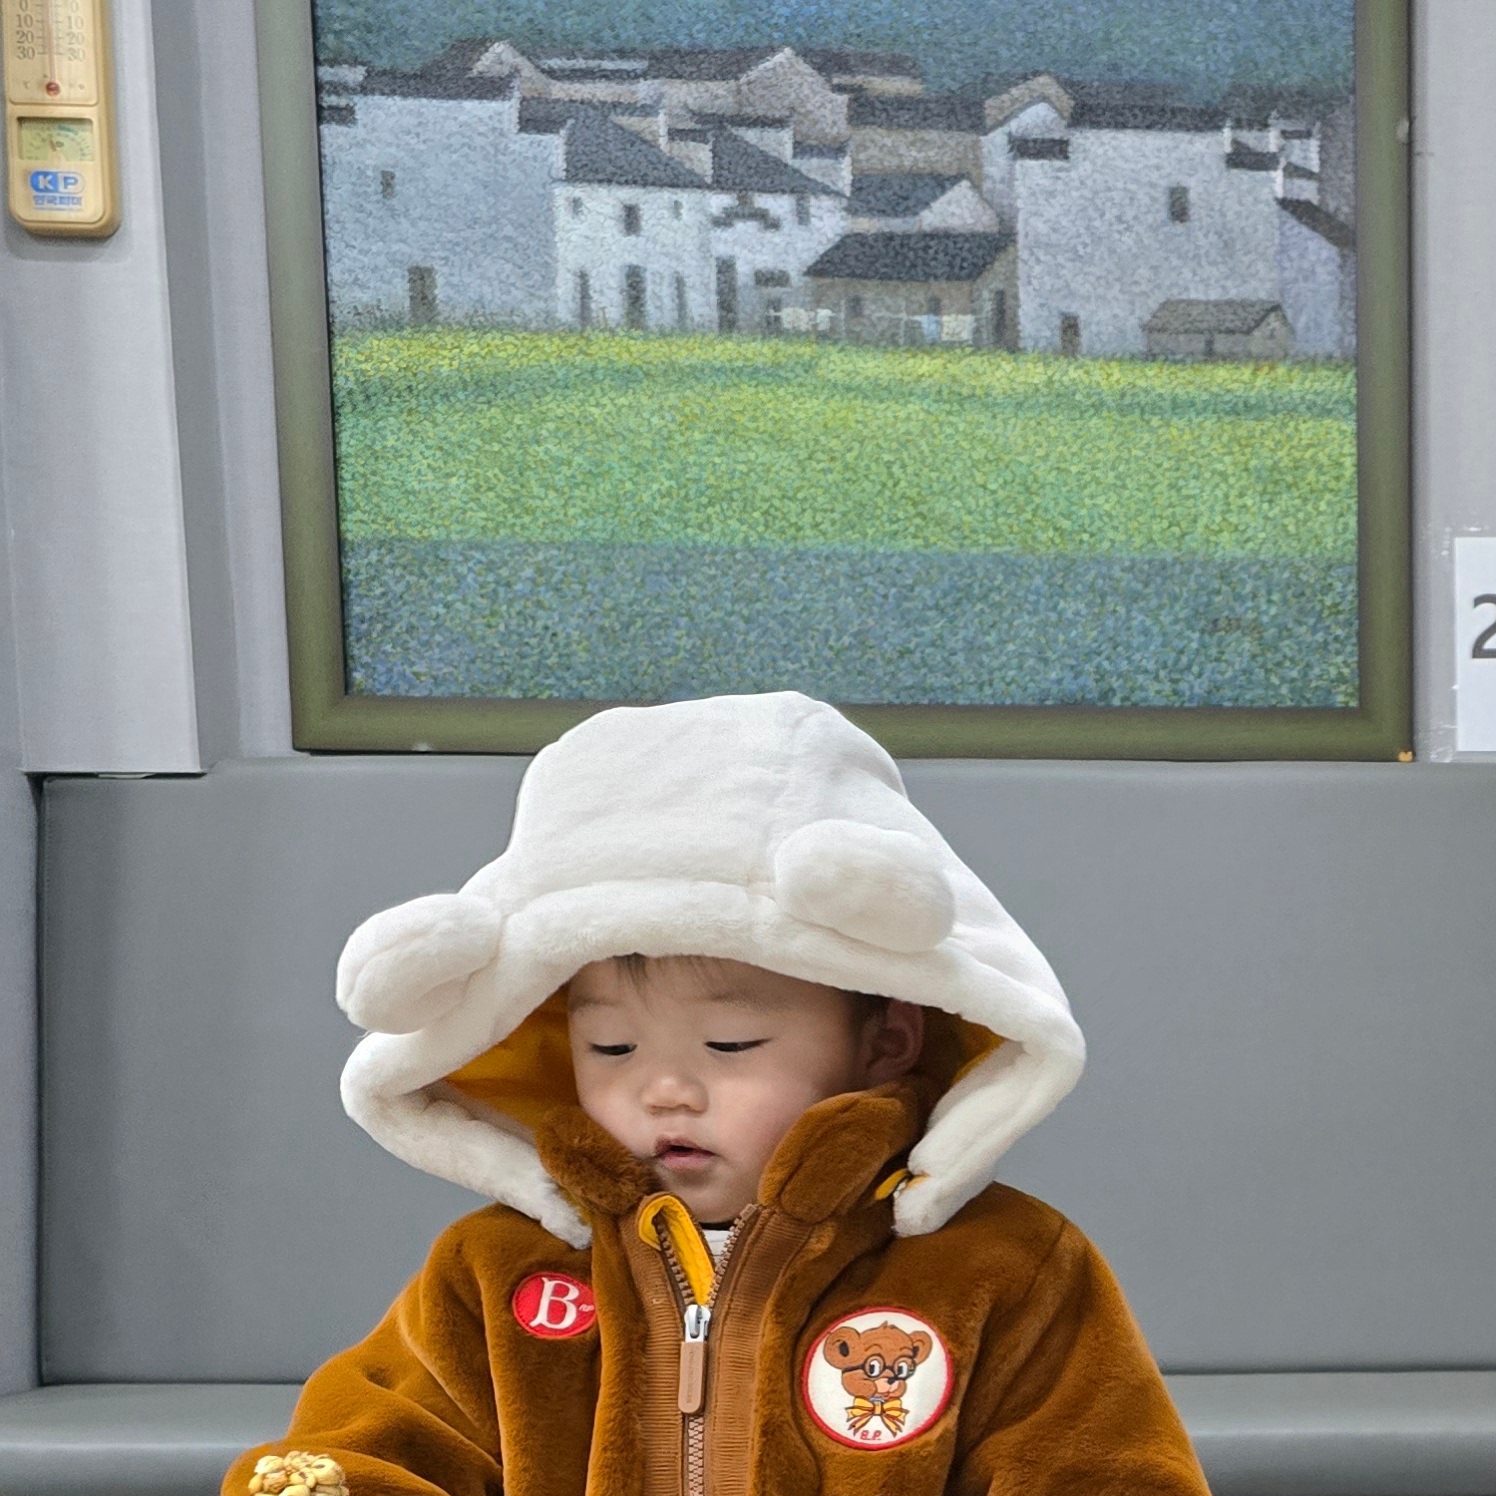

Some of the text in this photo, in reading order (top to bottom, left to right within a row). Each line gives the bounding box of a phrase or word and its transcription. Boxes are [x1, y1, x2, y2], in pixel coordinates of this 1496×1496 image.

[16, 13, 34, 28] 10
[67, 15, 84, 30] 10
[16, 30, 35, 44] 20
[66, 31, 86, 46] 20
[16, 46, 36, 61] 30
